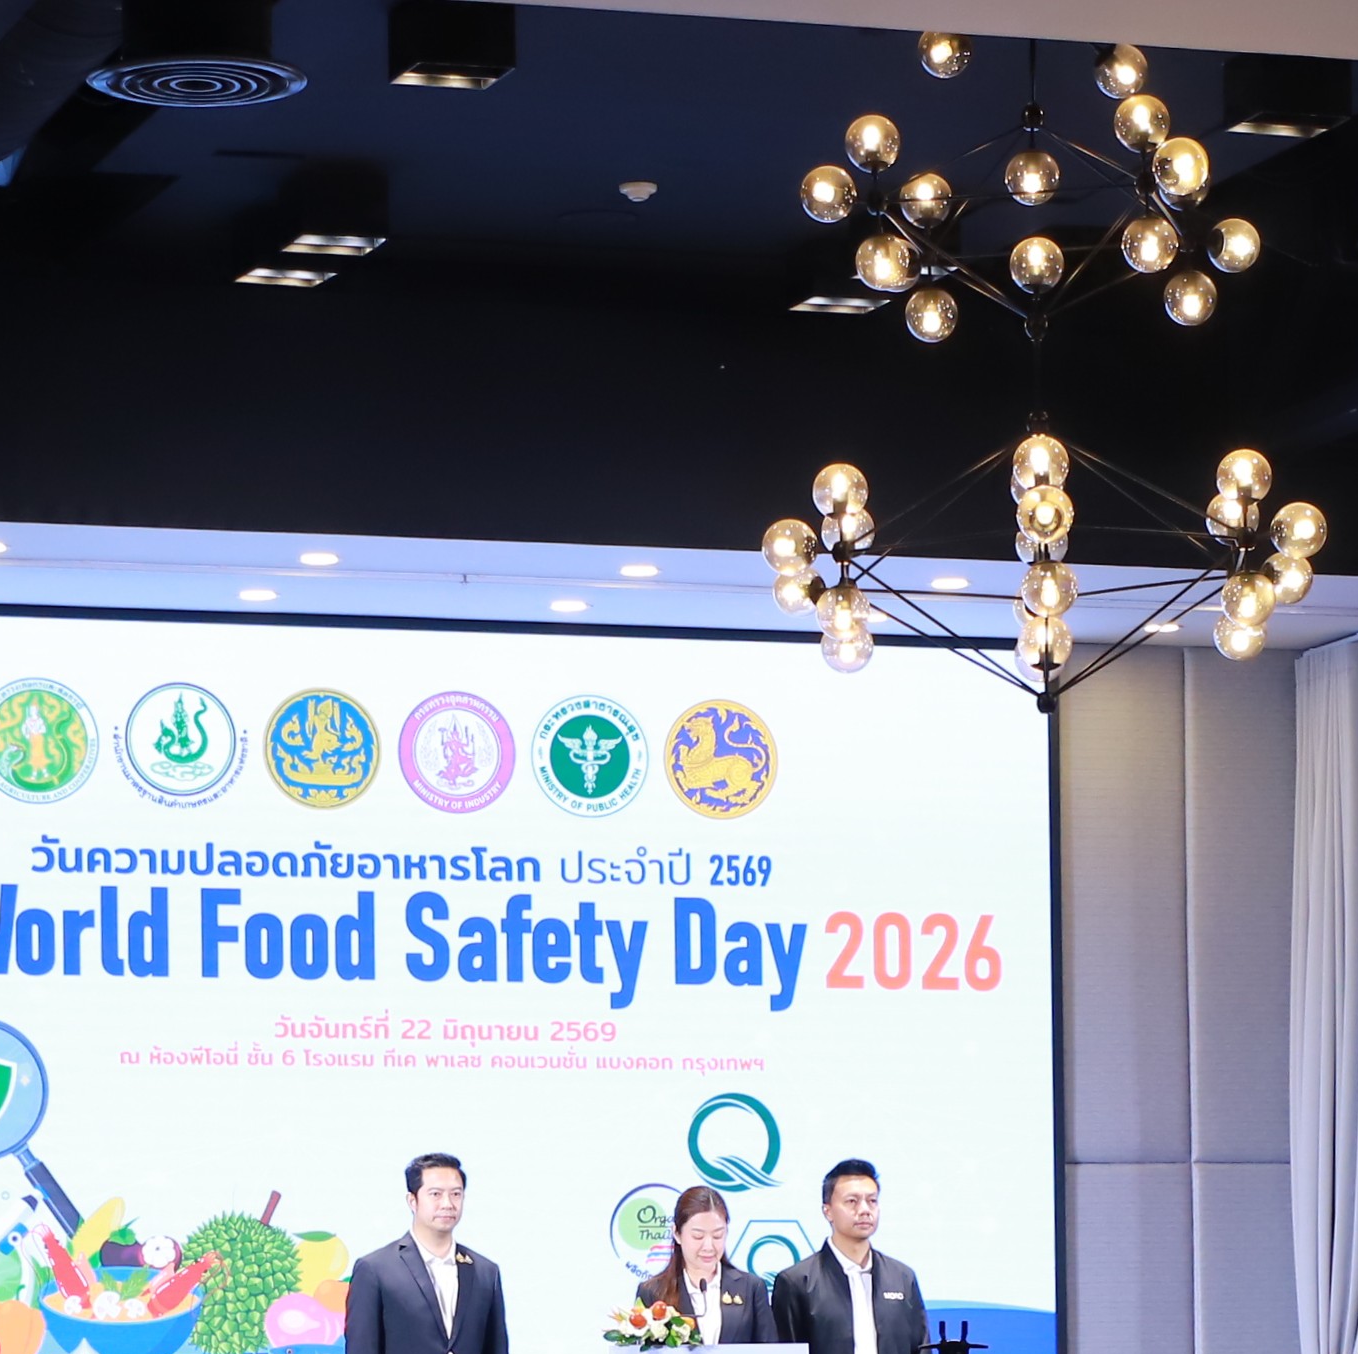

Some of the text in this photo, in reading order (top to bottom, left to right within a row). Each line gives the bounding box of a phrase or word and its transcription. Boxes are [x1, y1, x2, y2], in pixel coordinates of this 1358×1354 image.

[413, 779, 502, 810] MINISTRY OF INDUSTRY
[540, 766, 642, 812] MINISTRY OF PUBLIC HEALTH
[31, 835, 771, 887] วันความปลอดภัยอาหารโลก ประจำปี 2569
[201, 887, 375, 981] Food
[405, 891, 648, 1010] Safety
[675, 896, 807, 1012] Day
[825, 912, 1003, 992] 2026
[274, 1009, 617, 1047] วันจันทร์ที่ 22 มิถุนายน 2569
[120, 1051, 140, 1065] ณ
[247, 1042, 273, 1066] ชั้น
[282, 1050, 296, 1066] 6
[304, 1049, 374, 1068] โรงแรม
[383, 1049, 417, 1067] ทีเค
[491, 1046, 587, 1069] คอนเวนชั่น
[596, 1055, 673, 1070] แบงคอก
[681, 1056, 765, 1076] กรุงเทพฯ
